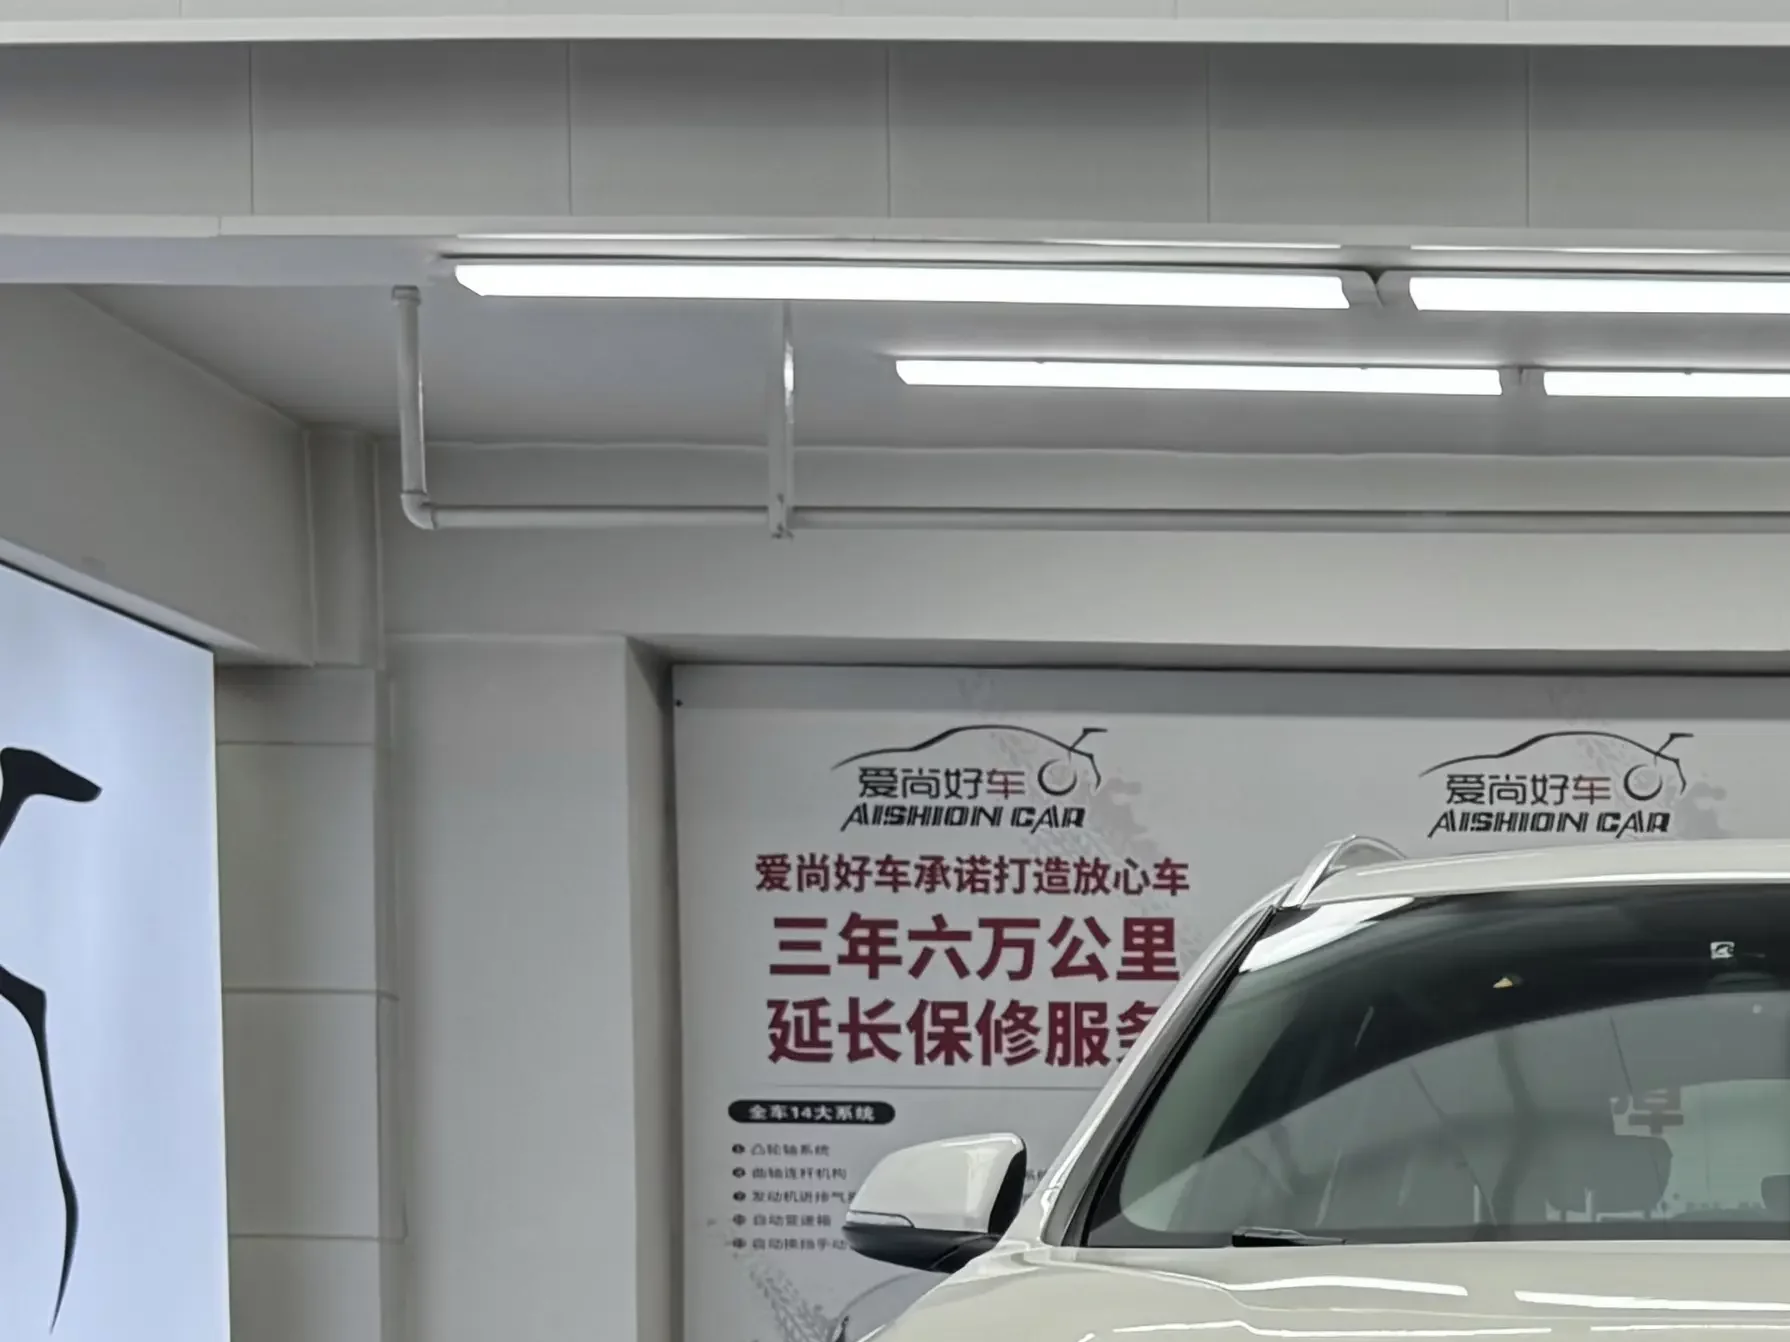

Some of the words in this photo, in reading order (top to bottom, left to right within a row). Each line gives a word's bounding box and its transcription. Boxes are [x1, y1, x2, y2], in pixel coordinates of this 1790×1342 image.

[858, 767, 1025, 800] 爱尚好车
[1446, 773, 1611, 806] 爱尚好车
[841, 802, 1006, 832] AISHION
[1010, 803, 1086, 835] CAR
[1427, 808, 1589, 839] AISHION
[1595, 809, 1671, 840] CAR
[756, 854, 1189, 896] 爱尚好车承诺打造放心车
[769, 912, 1181, 982] 三年六万公里
